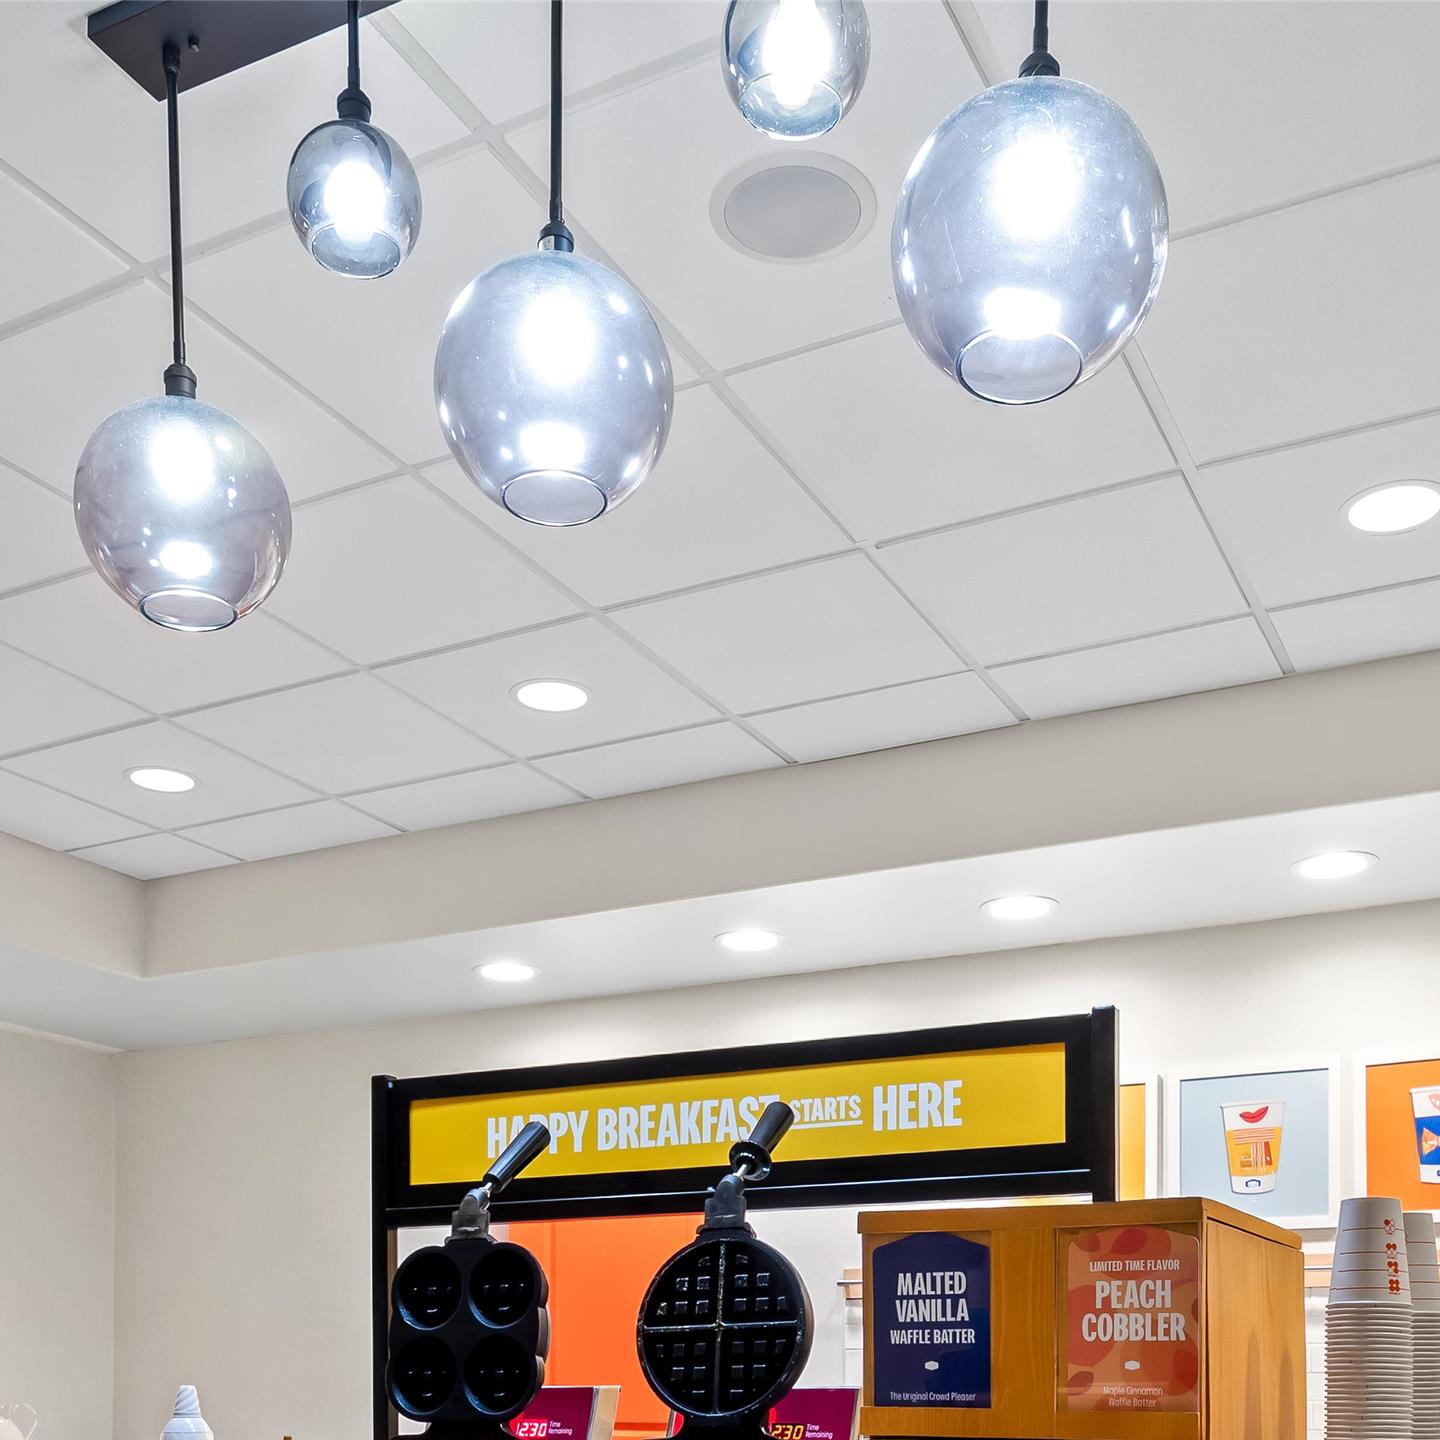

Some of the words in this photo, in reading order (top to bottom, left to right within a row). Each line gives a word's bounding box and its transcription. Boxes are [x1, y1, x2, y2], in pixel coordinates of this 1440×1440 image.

[790, 1094, 862, 1123] STARTS
[873, 1080, 963, 1131] HERE
[1090, 1260, 1122, 1272] LIMITED
[1125, 1260, 1145, 1271] TIME
[1147, 1259, 1180, 1271] FLAVOR
[897, 1271, 967, 1296] MALTED
[1095, 1279, 1172, 1309] PEACH
[895, 1298, 970, 1323] VANILLA
[1082, 1312, 1186, 1341] COBBLER
[890, 1329, 931, 1345] WAFFLE
[933, 1328, 976, 1344] BATTER
[890, 1391, 902, 1401] The
[902, 1392, 928, 1403] Original
[929, 1391, 950, 1401] Crowd
[951, 1391, 976, 1401] Pleaser
[1103, 1386, 1125, 1397] Maple
[1126, 1386, 1163, 1396] Cinnamon
[1109, 1397, 1132, 1407] Waffle
[1133, 1398, 1157, 1407] Batter
[549, 1420, 561, 1428] Time
[548, 1428, 573, 1436] Remaining
[805, 1431, 833, 1440] Remaining
